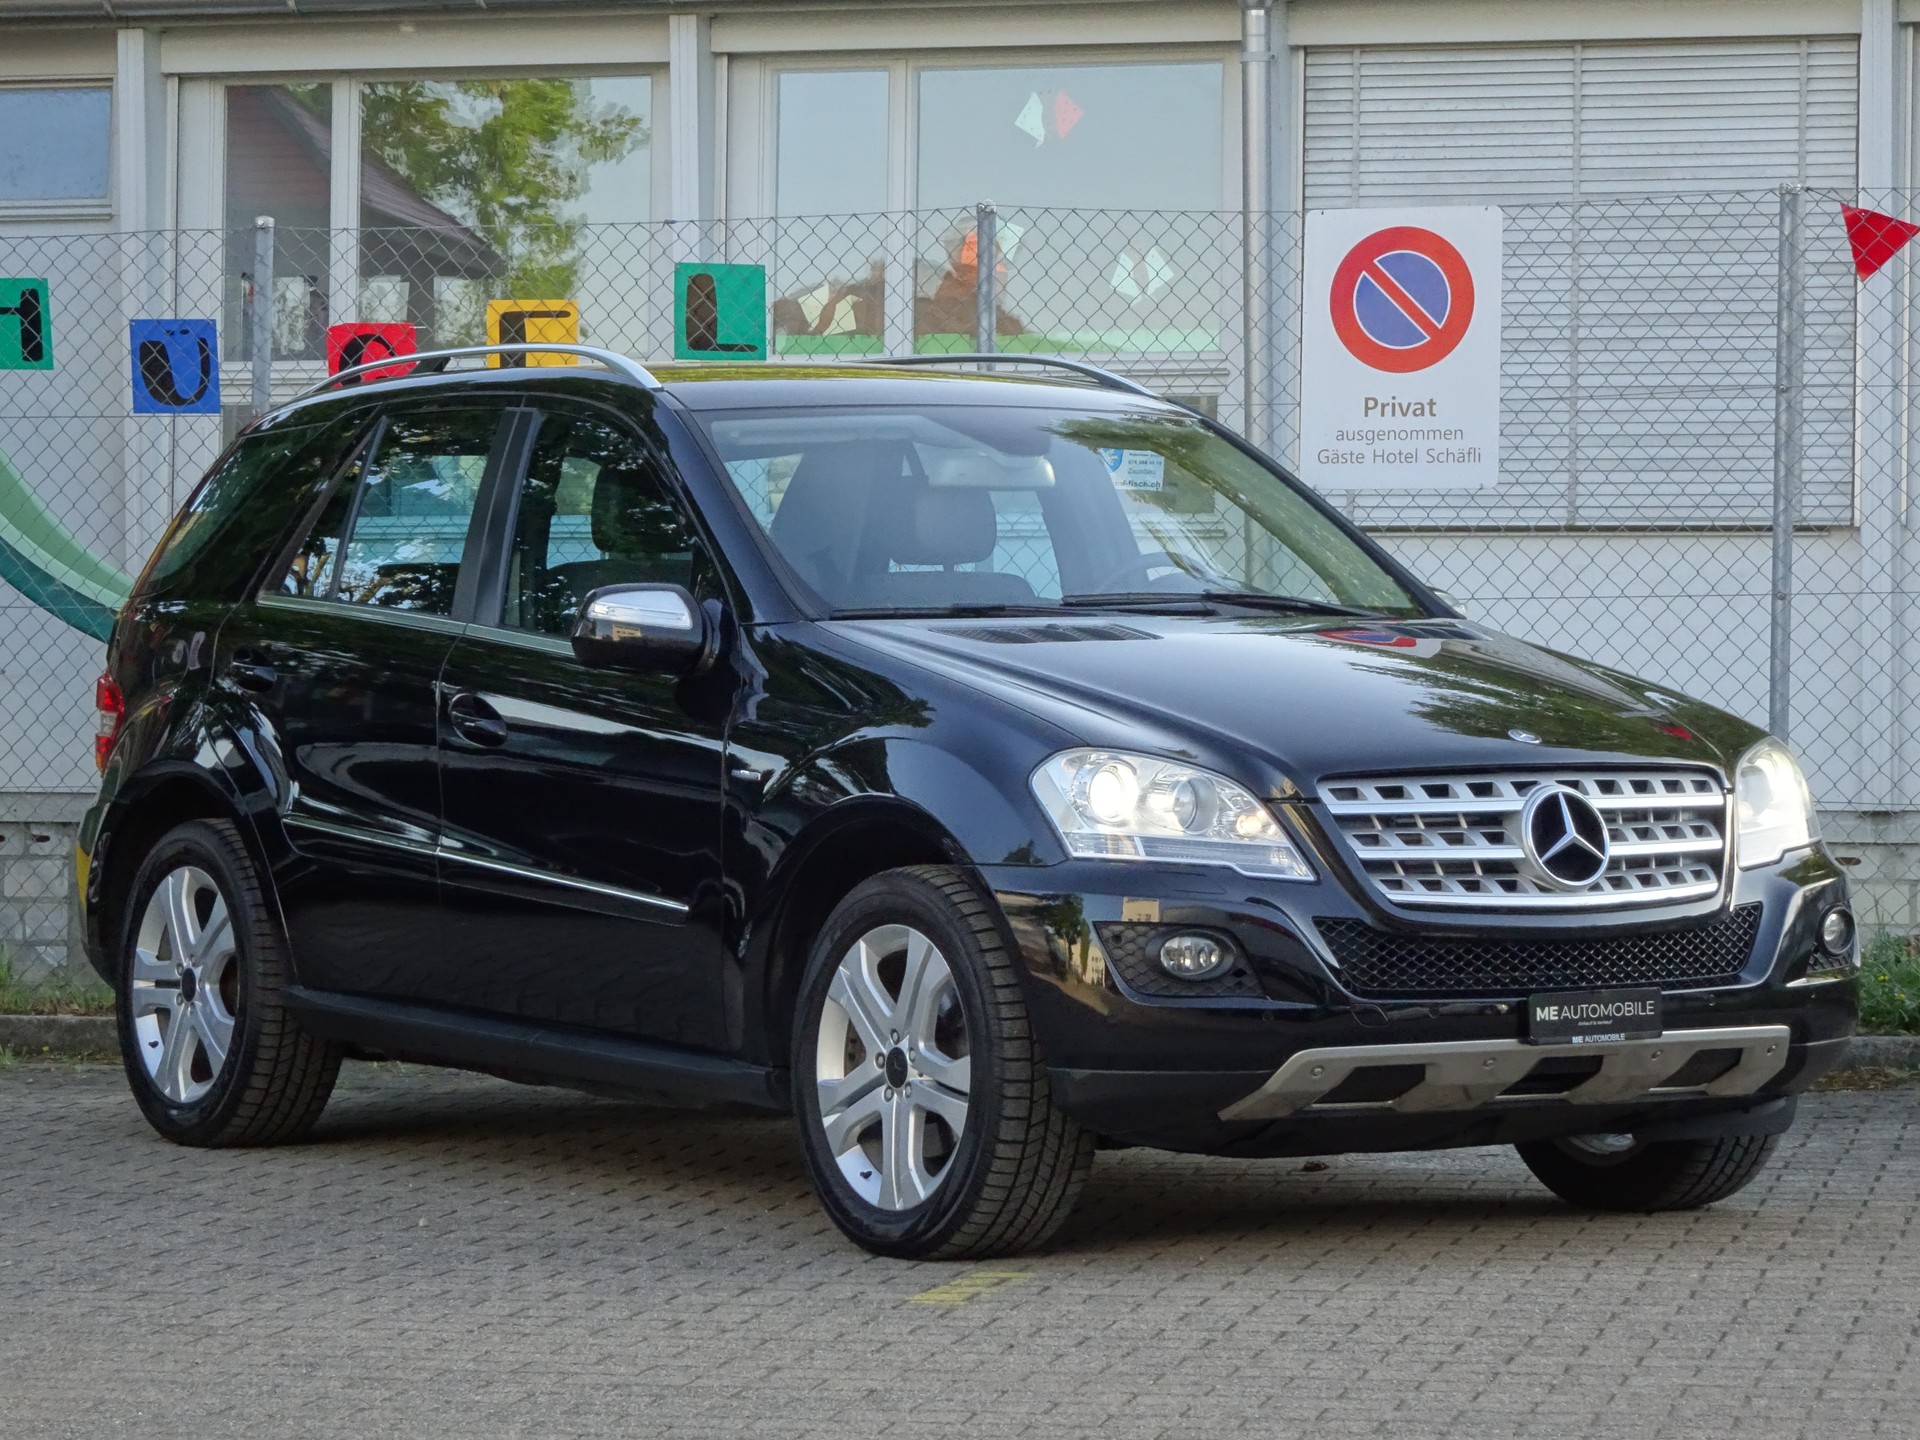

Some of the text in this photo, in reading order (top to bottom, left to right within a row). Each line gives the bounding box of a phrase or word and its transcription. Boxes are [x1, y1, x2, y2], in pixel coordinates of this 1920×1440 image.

[1363, 396, 1437, 417] Privat
[1335, 428, 1464, 445] ausgenommen
[1317, 447, 1482, 464] Gäste Hotel Schäfli
[1536, 1001, 1655, 1021] ME AUTOMOBILE
[1572, 1033, 1625, 1044] ME AUTOMOBILE
